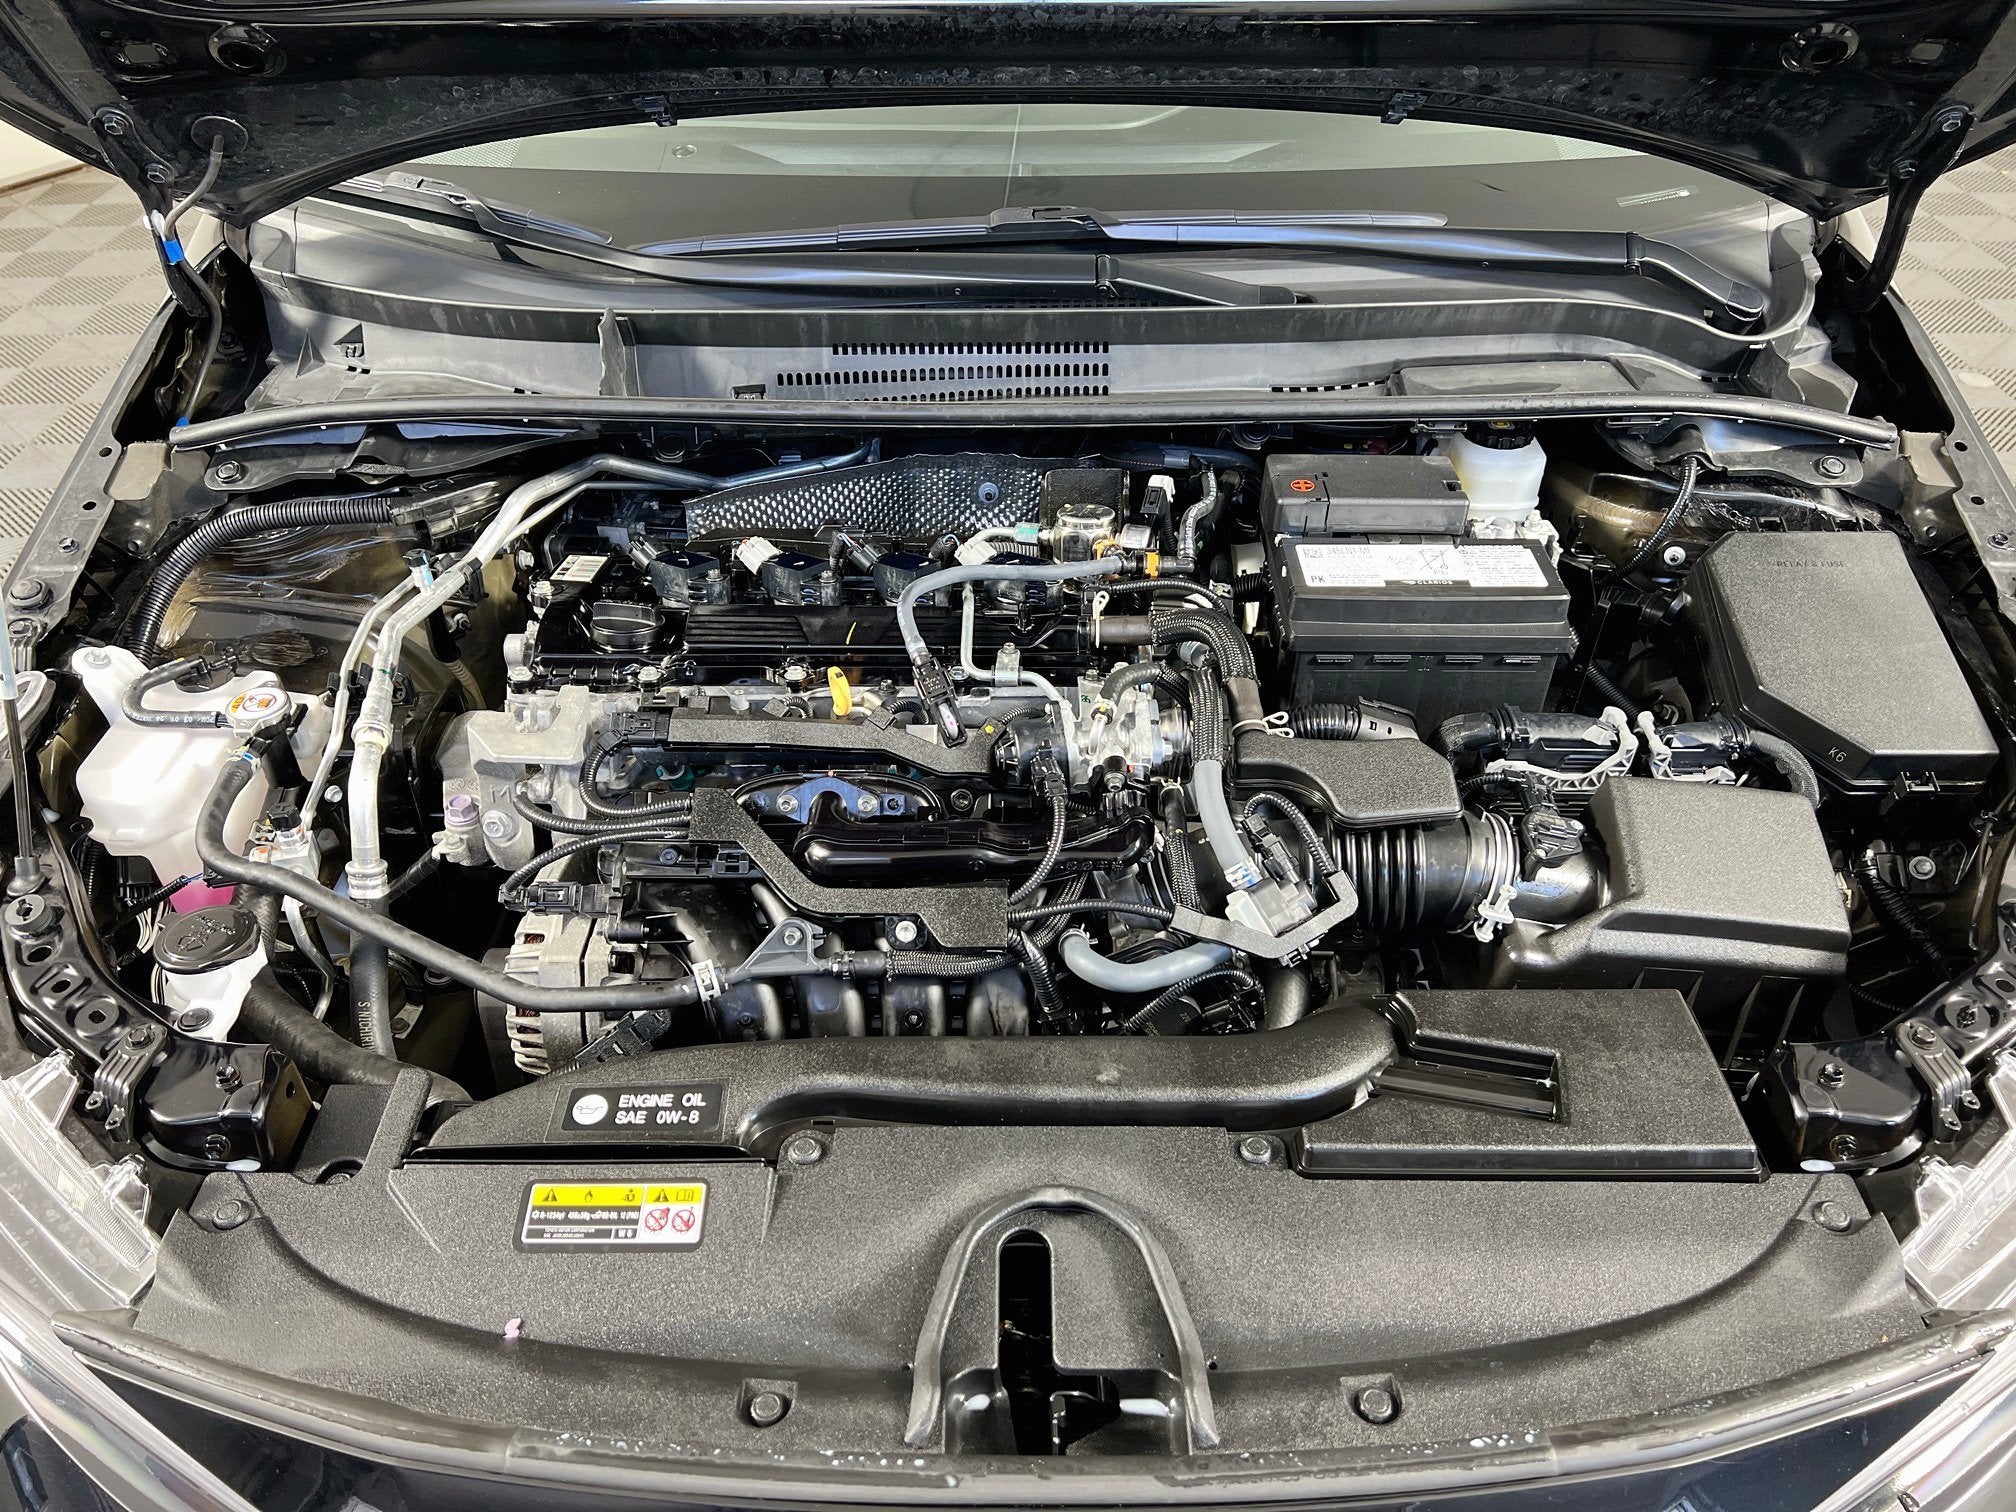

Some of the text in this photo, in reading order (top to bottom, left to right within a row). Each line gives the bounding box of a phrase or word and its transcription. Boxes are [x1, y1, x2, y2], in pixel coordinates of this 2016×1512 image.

[1777, 560, 1809, 568] RELAY
[1821, 560, 1846, 568] FUSE
[1310, 575, 1326, 583] PK
[1828, 747, 1847, 762] K6
[618, 1093, 707, 1108] ENGINE OIL
[614, 1110, 700, 1124] SAE 0W-8
